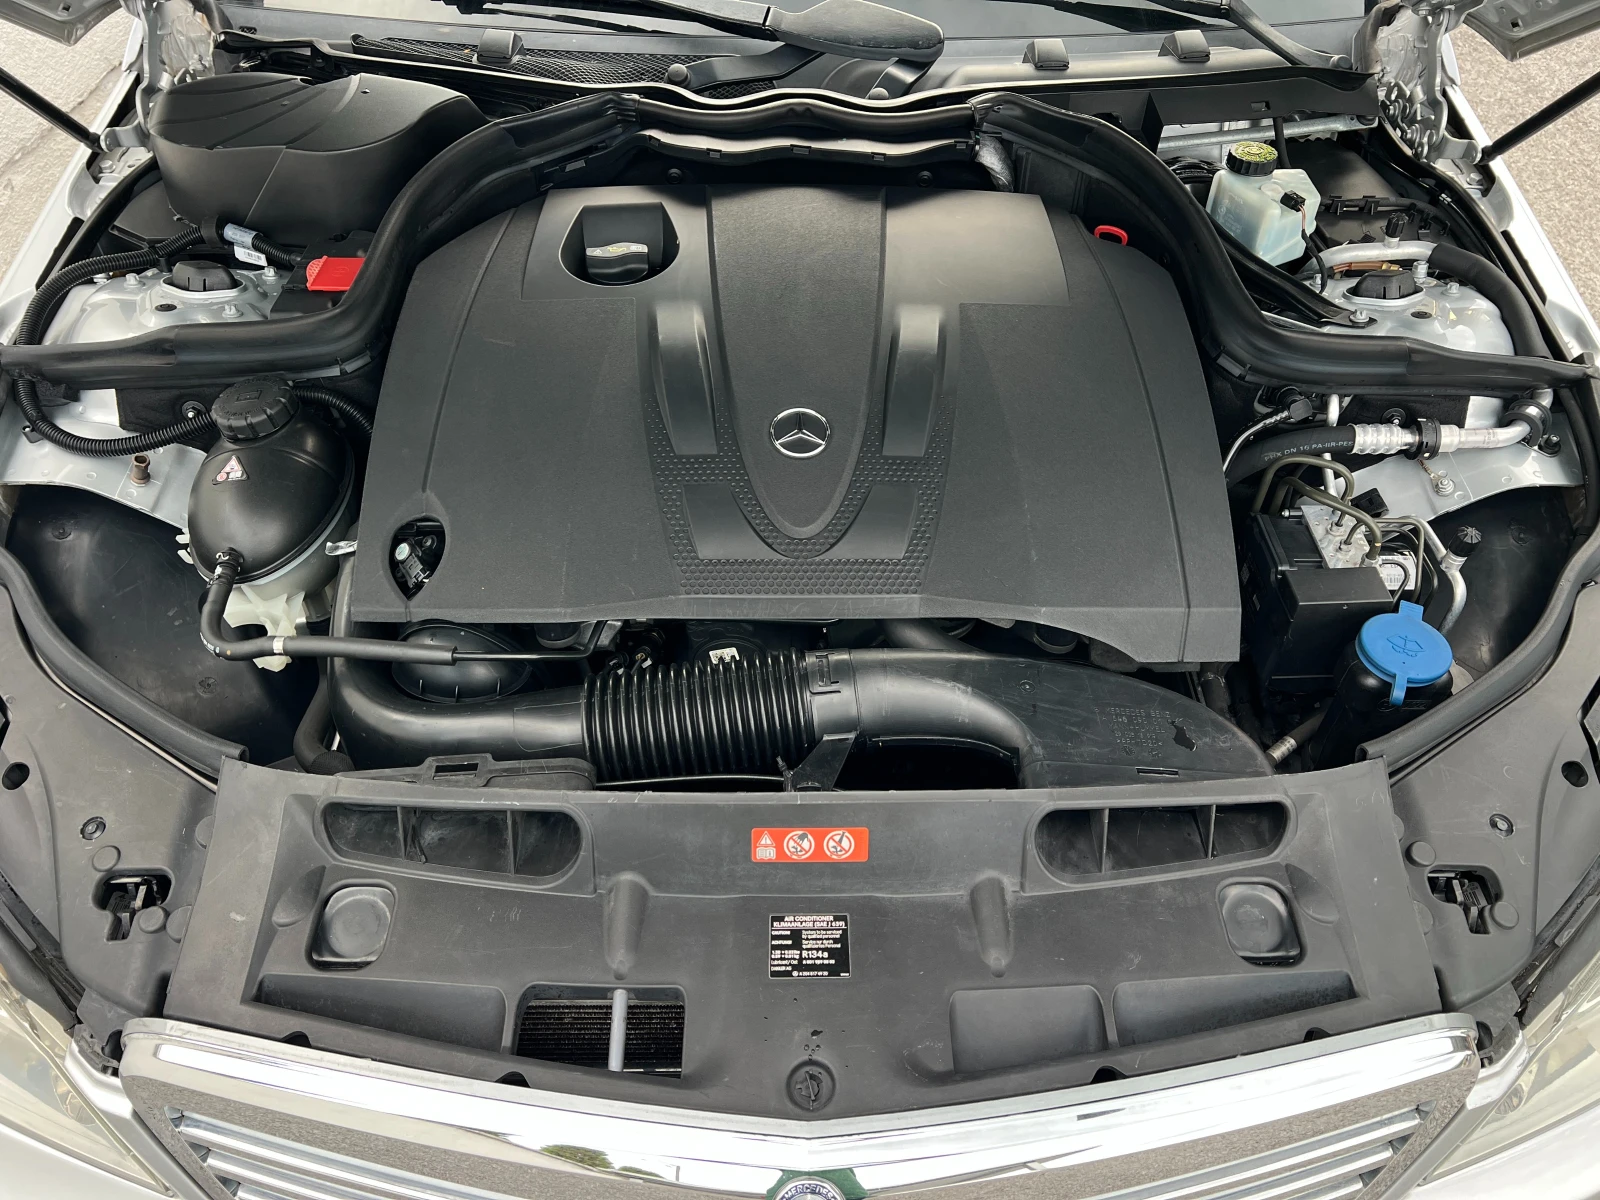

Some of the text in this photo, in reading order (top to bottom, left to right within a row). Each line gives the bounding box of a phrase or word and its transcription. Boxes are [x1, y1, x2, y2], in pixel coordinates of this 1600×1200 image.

[1284, 447, 1297, 455] DN
[801, 950, 829, 959] R134a
[784, 1183, 834, 1200] MERCEDES
